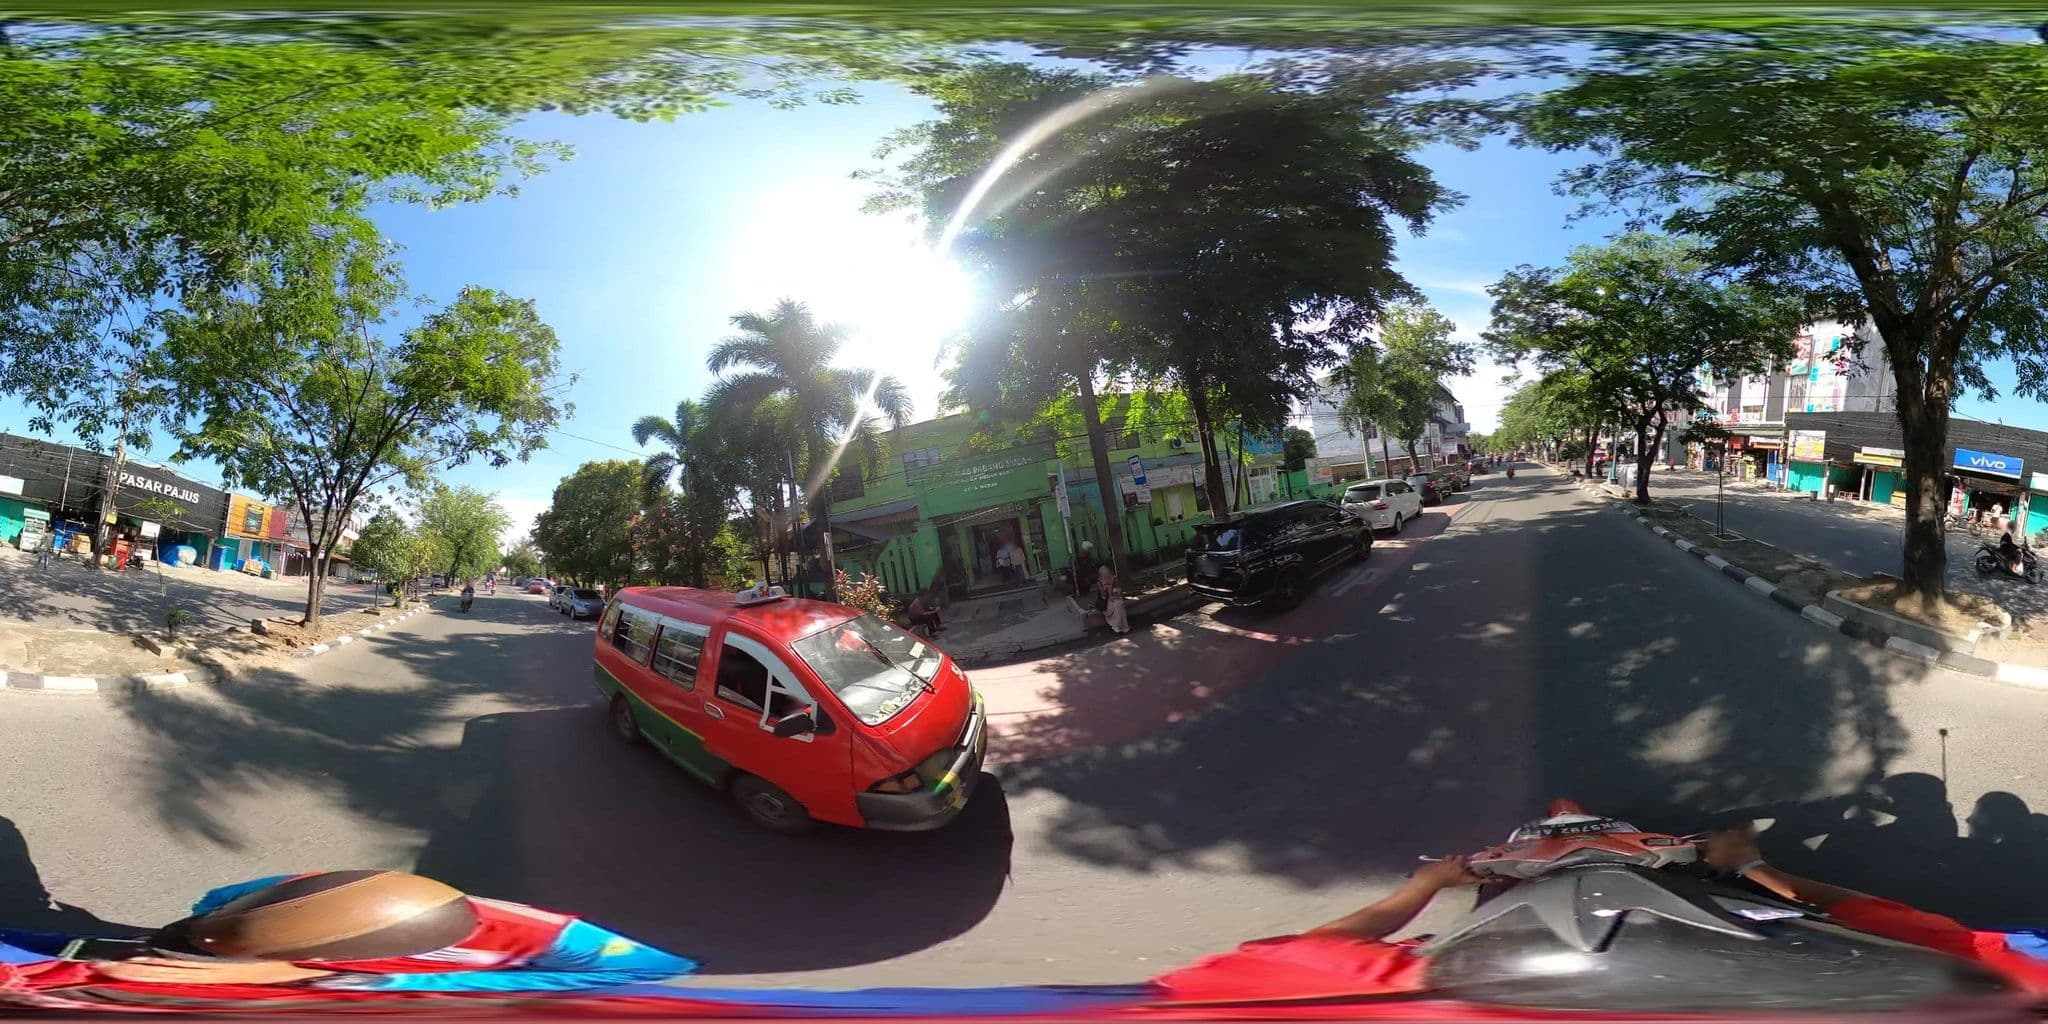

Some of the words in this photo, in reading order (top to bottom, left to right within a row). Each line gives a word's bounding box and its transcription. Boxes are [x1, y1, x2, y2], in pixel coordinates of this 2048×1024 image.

[1971, 457, 2006, 469] vivo
[120, 472, 163, 494] PASAR
[163, 484, 200, 504] PAJUS
